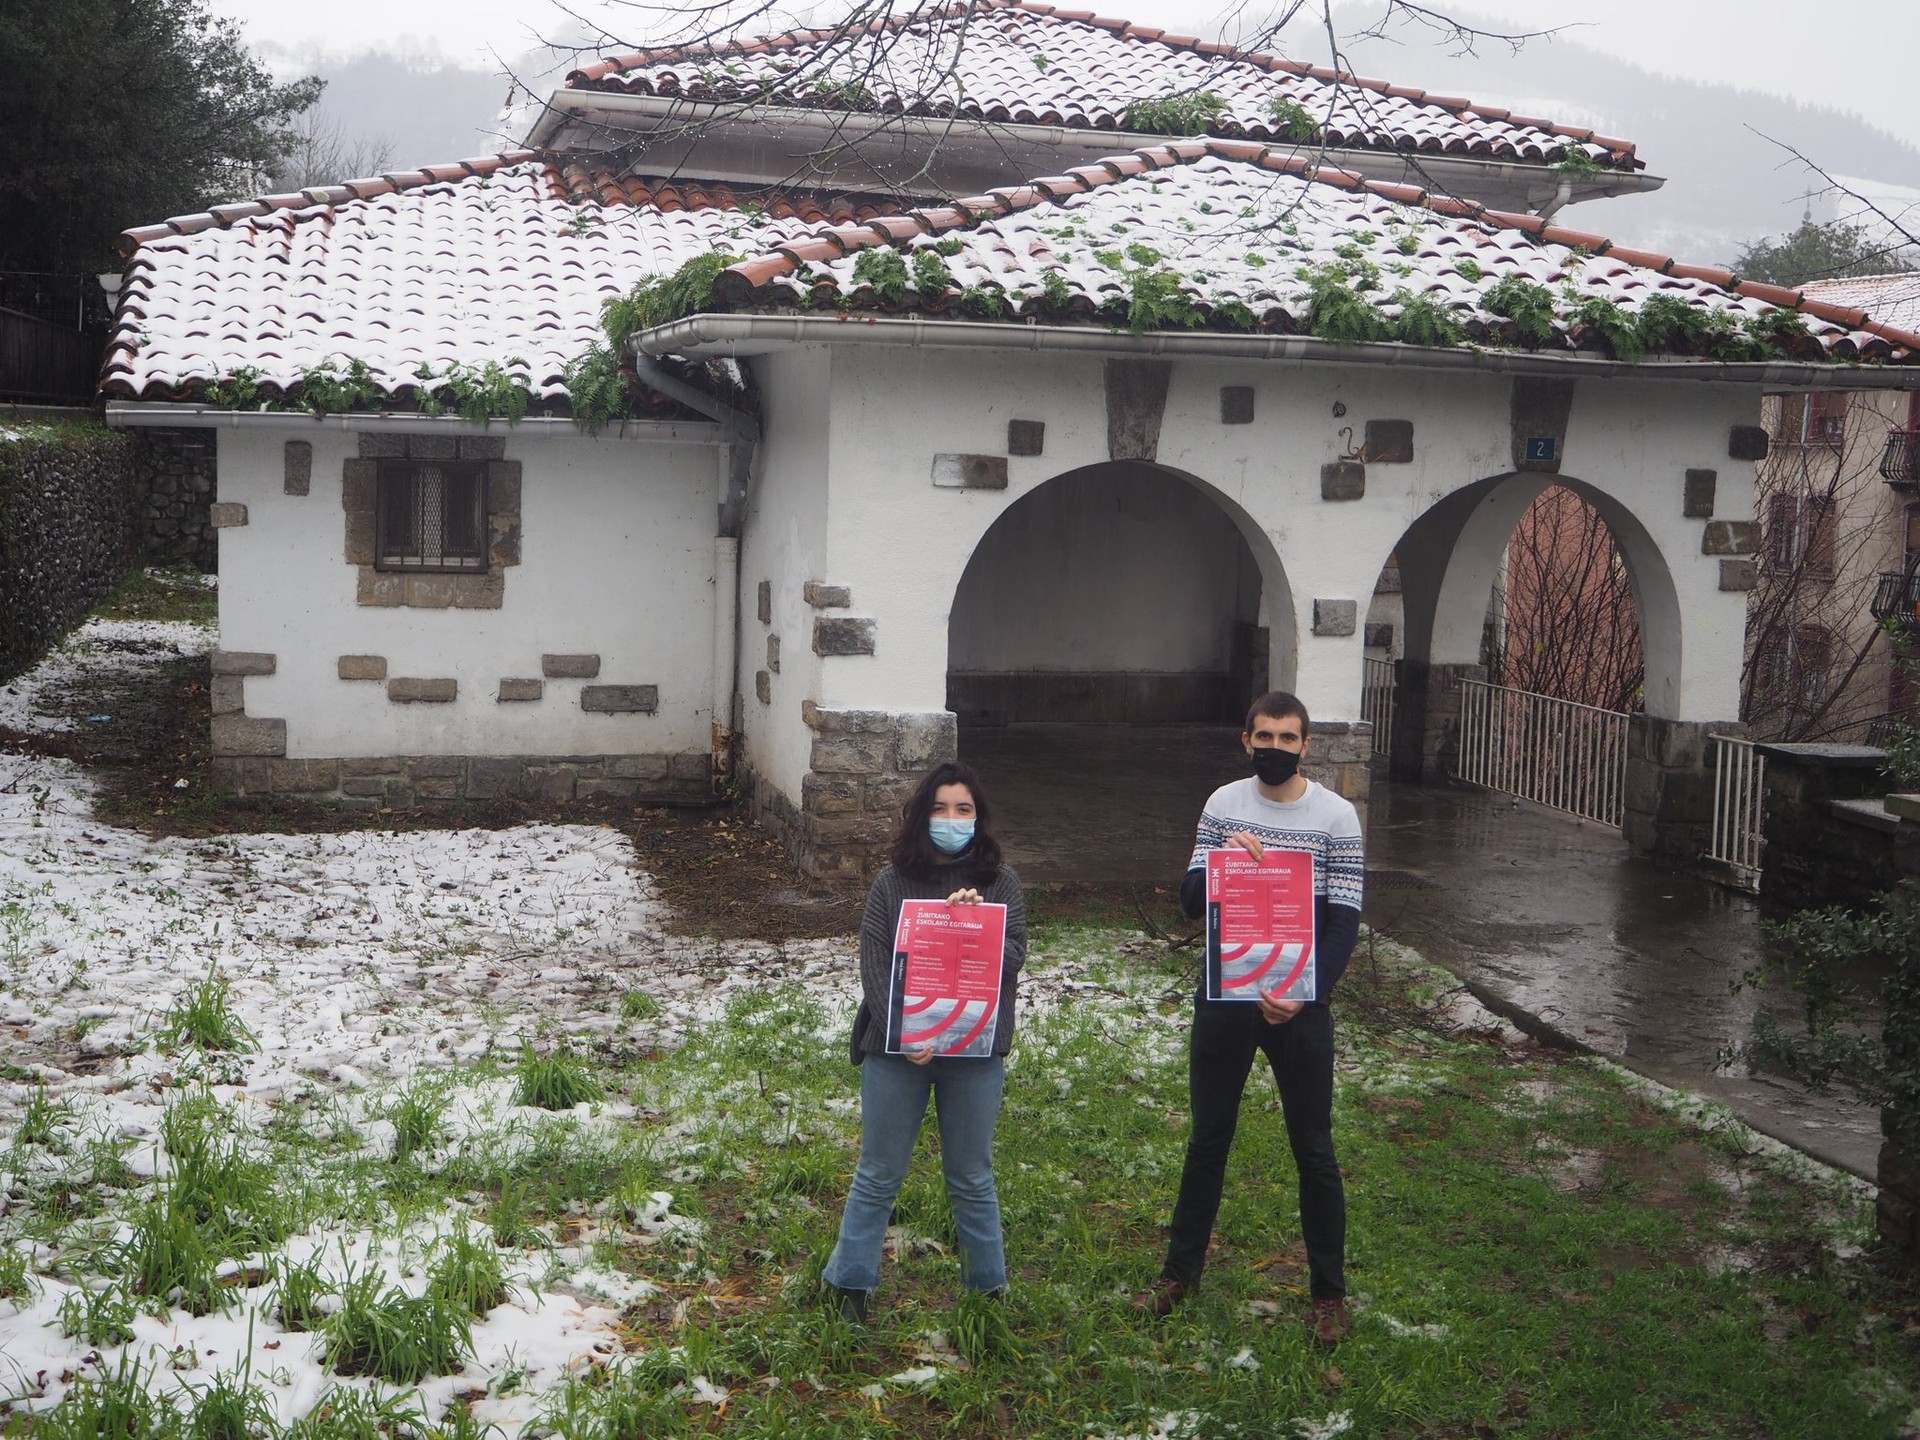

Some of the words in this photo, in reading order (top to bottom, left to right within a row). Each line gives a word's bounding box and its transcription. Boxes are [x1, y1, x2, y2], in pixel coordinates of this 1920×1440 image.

[1537, 441, 1544, 457] 2
[917, 912, 950, 920] ZUBITXAKO
[916, 919, 948, 927] ESKOLAKO
[949, 921, 983, 929] EGITARAUA
